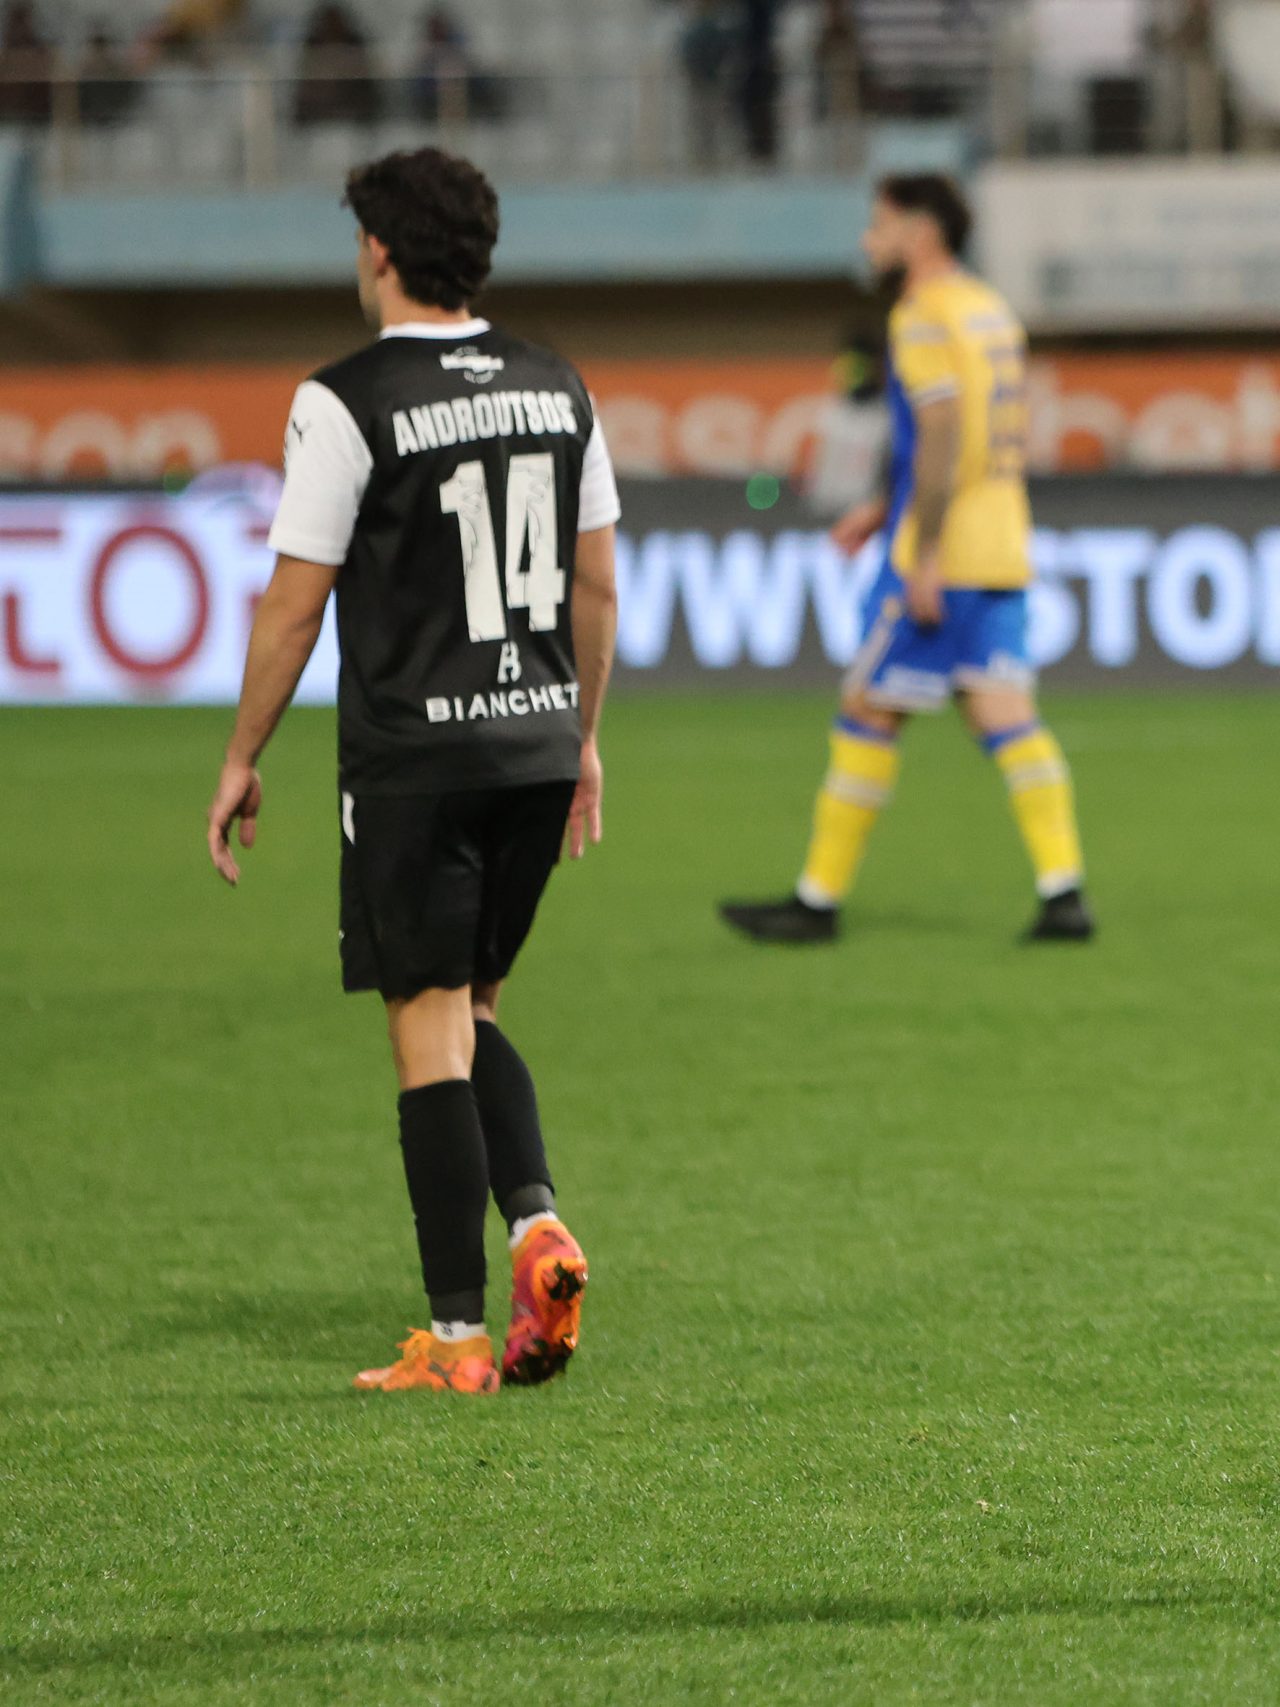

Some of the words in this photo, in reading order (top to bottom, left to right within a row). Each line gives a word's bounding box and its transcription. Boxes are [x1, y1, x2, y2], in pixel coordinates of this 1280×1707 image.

[392, 390, 578, 457] ANDROUTSOS
[439, 452, 566, 642] 14
[426, 682, 579, 723] BIANCHET
